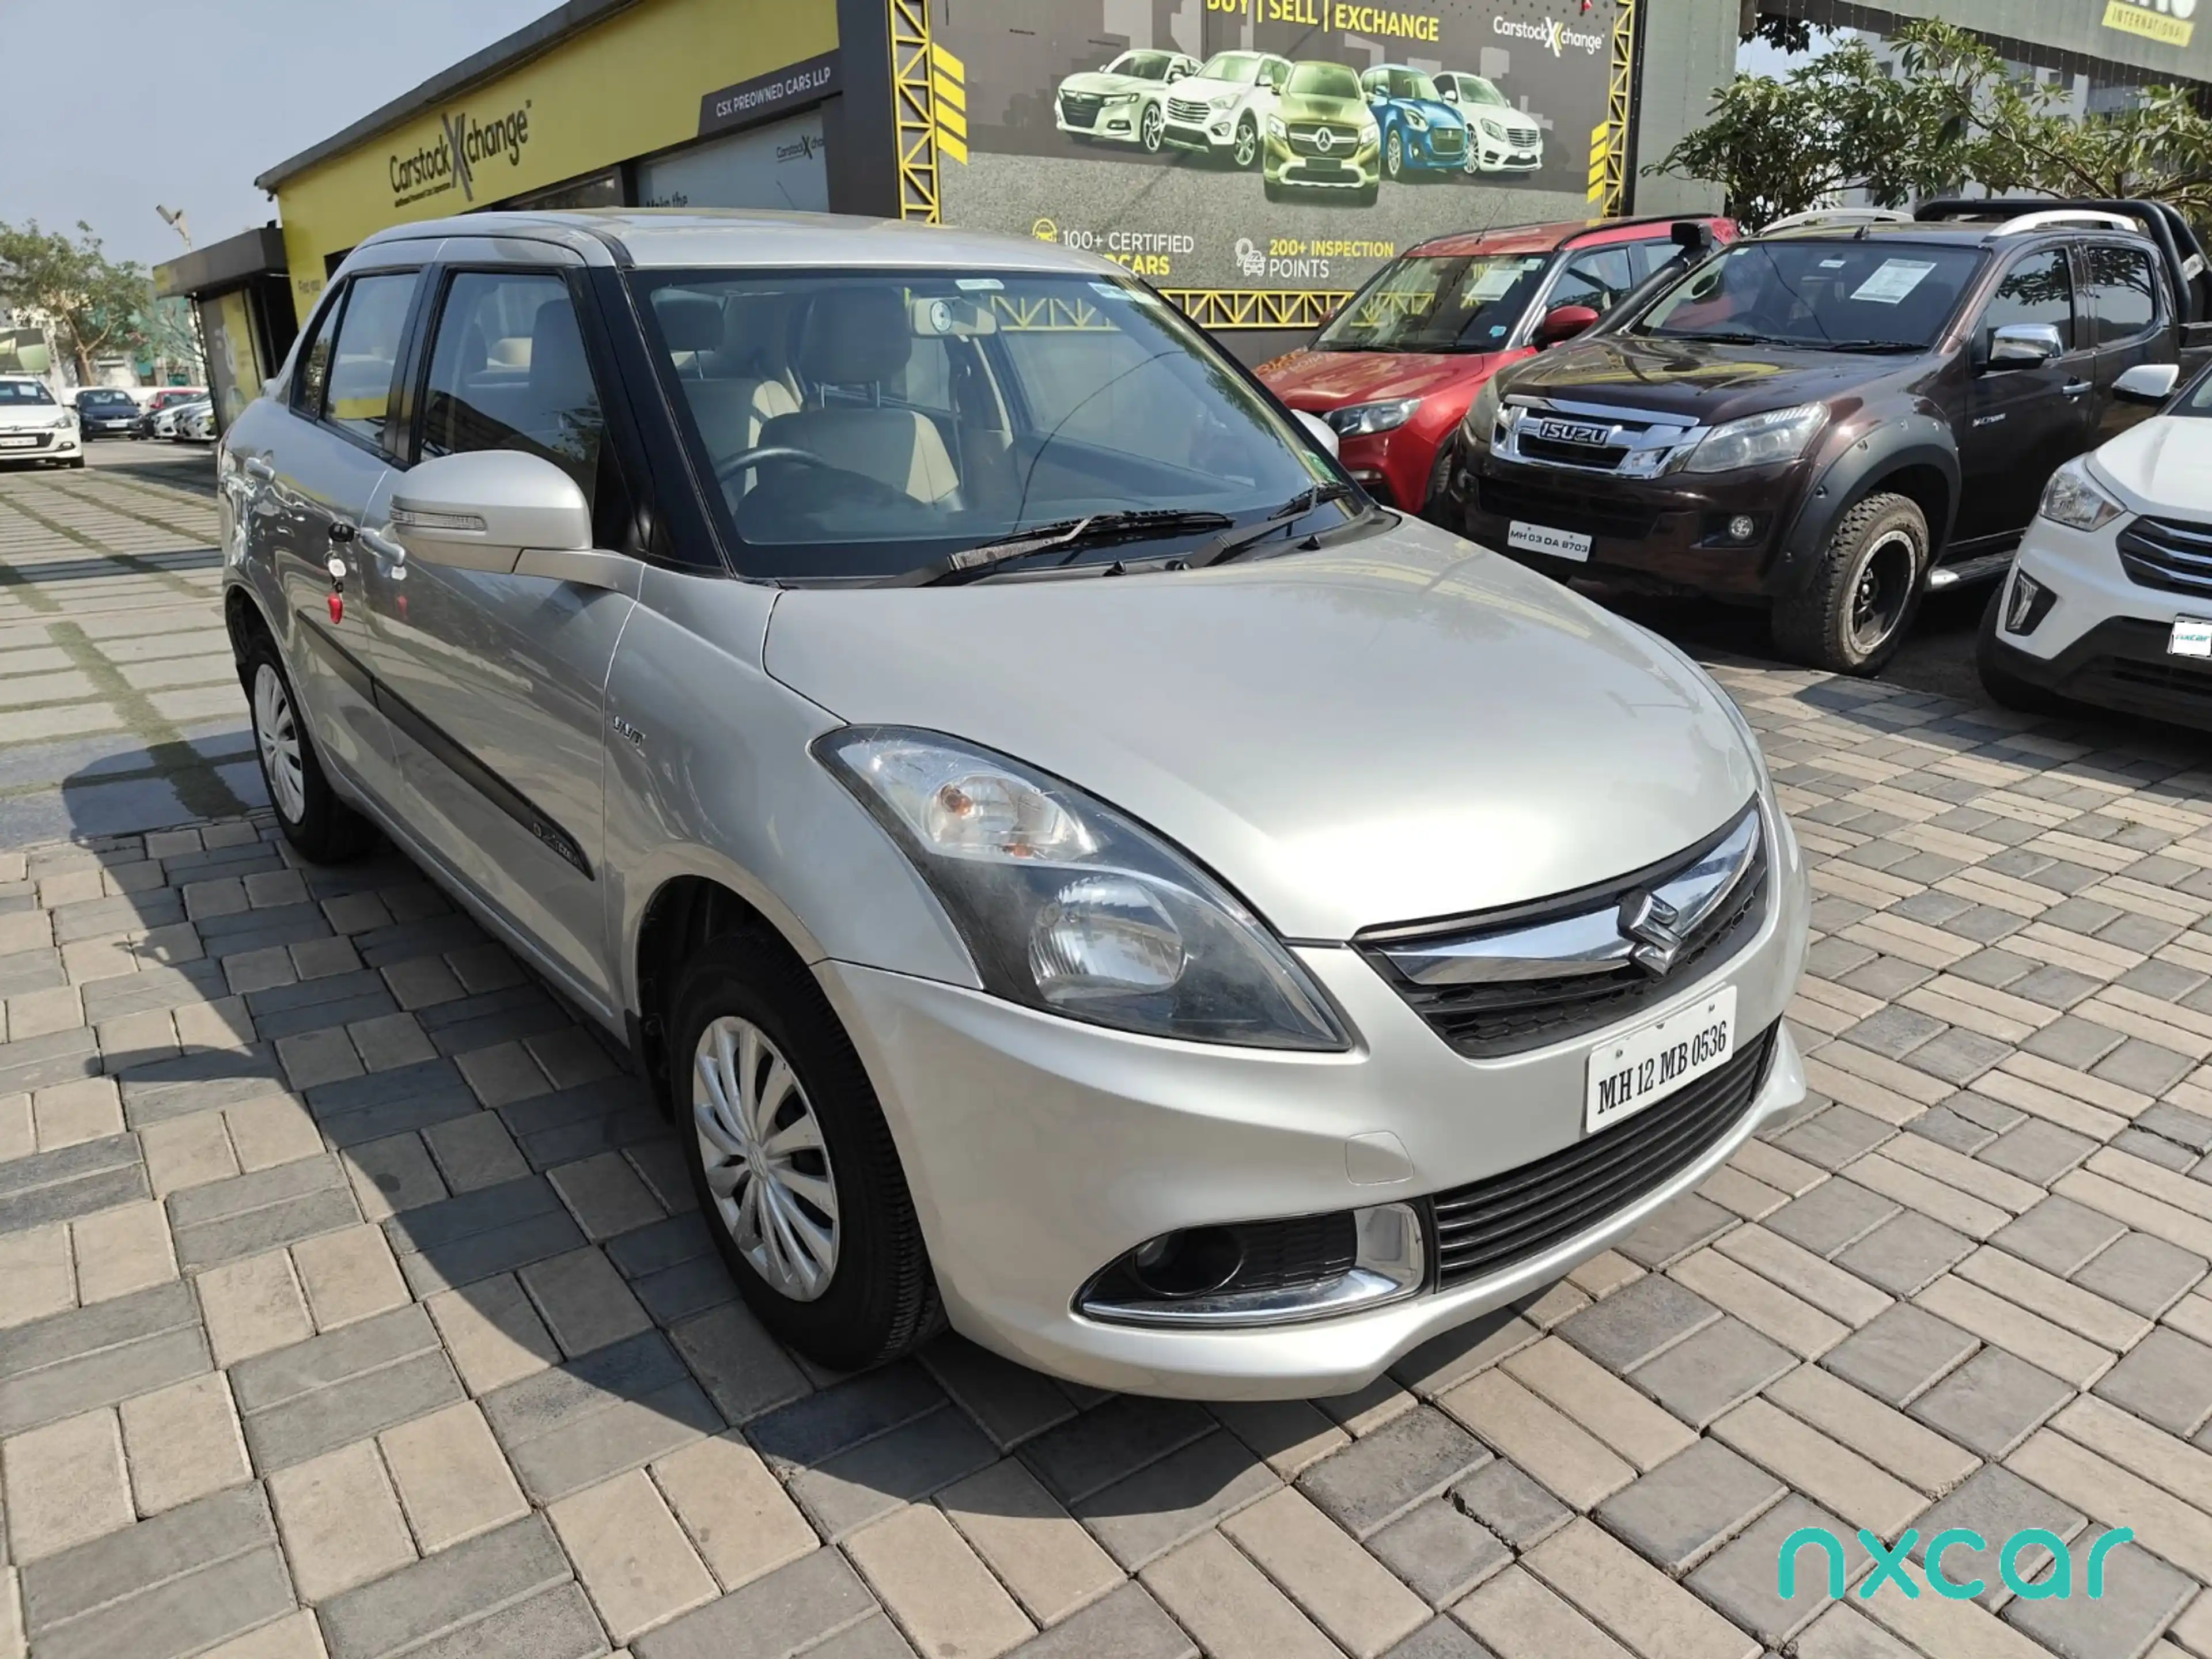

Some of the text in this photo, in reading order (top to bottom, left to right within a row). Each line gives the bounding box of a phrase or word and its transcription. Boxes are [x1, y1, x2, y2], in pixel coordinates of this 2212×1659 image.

[1268, 0, 1319, 25] SELL
[1335, 3, 1440, 41] EXCHANGE
[715, 66, 831, 118] CSX PREOWNED CARS LLP
[1063, 230, 1194, 253] 100+ CERTIFIED
[1269, 238, 1394, 257] 200+ INSPECTION
[1269, 259, 1330, 278] POINTS
[1541, 422, 1608, 444] ISUZU
[1510, 530, 1527, 540] MH
[1528, 533, 1542, 543] 03
[1597, 1020, 1727, 1115] MH 12 MB 0536
